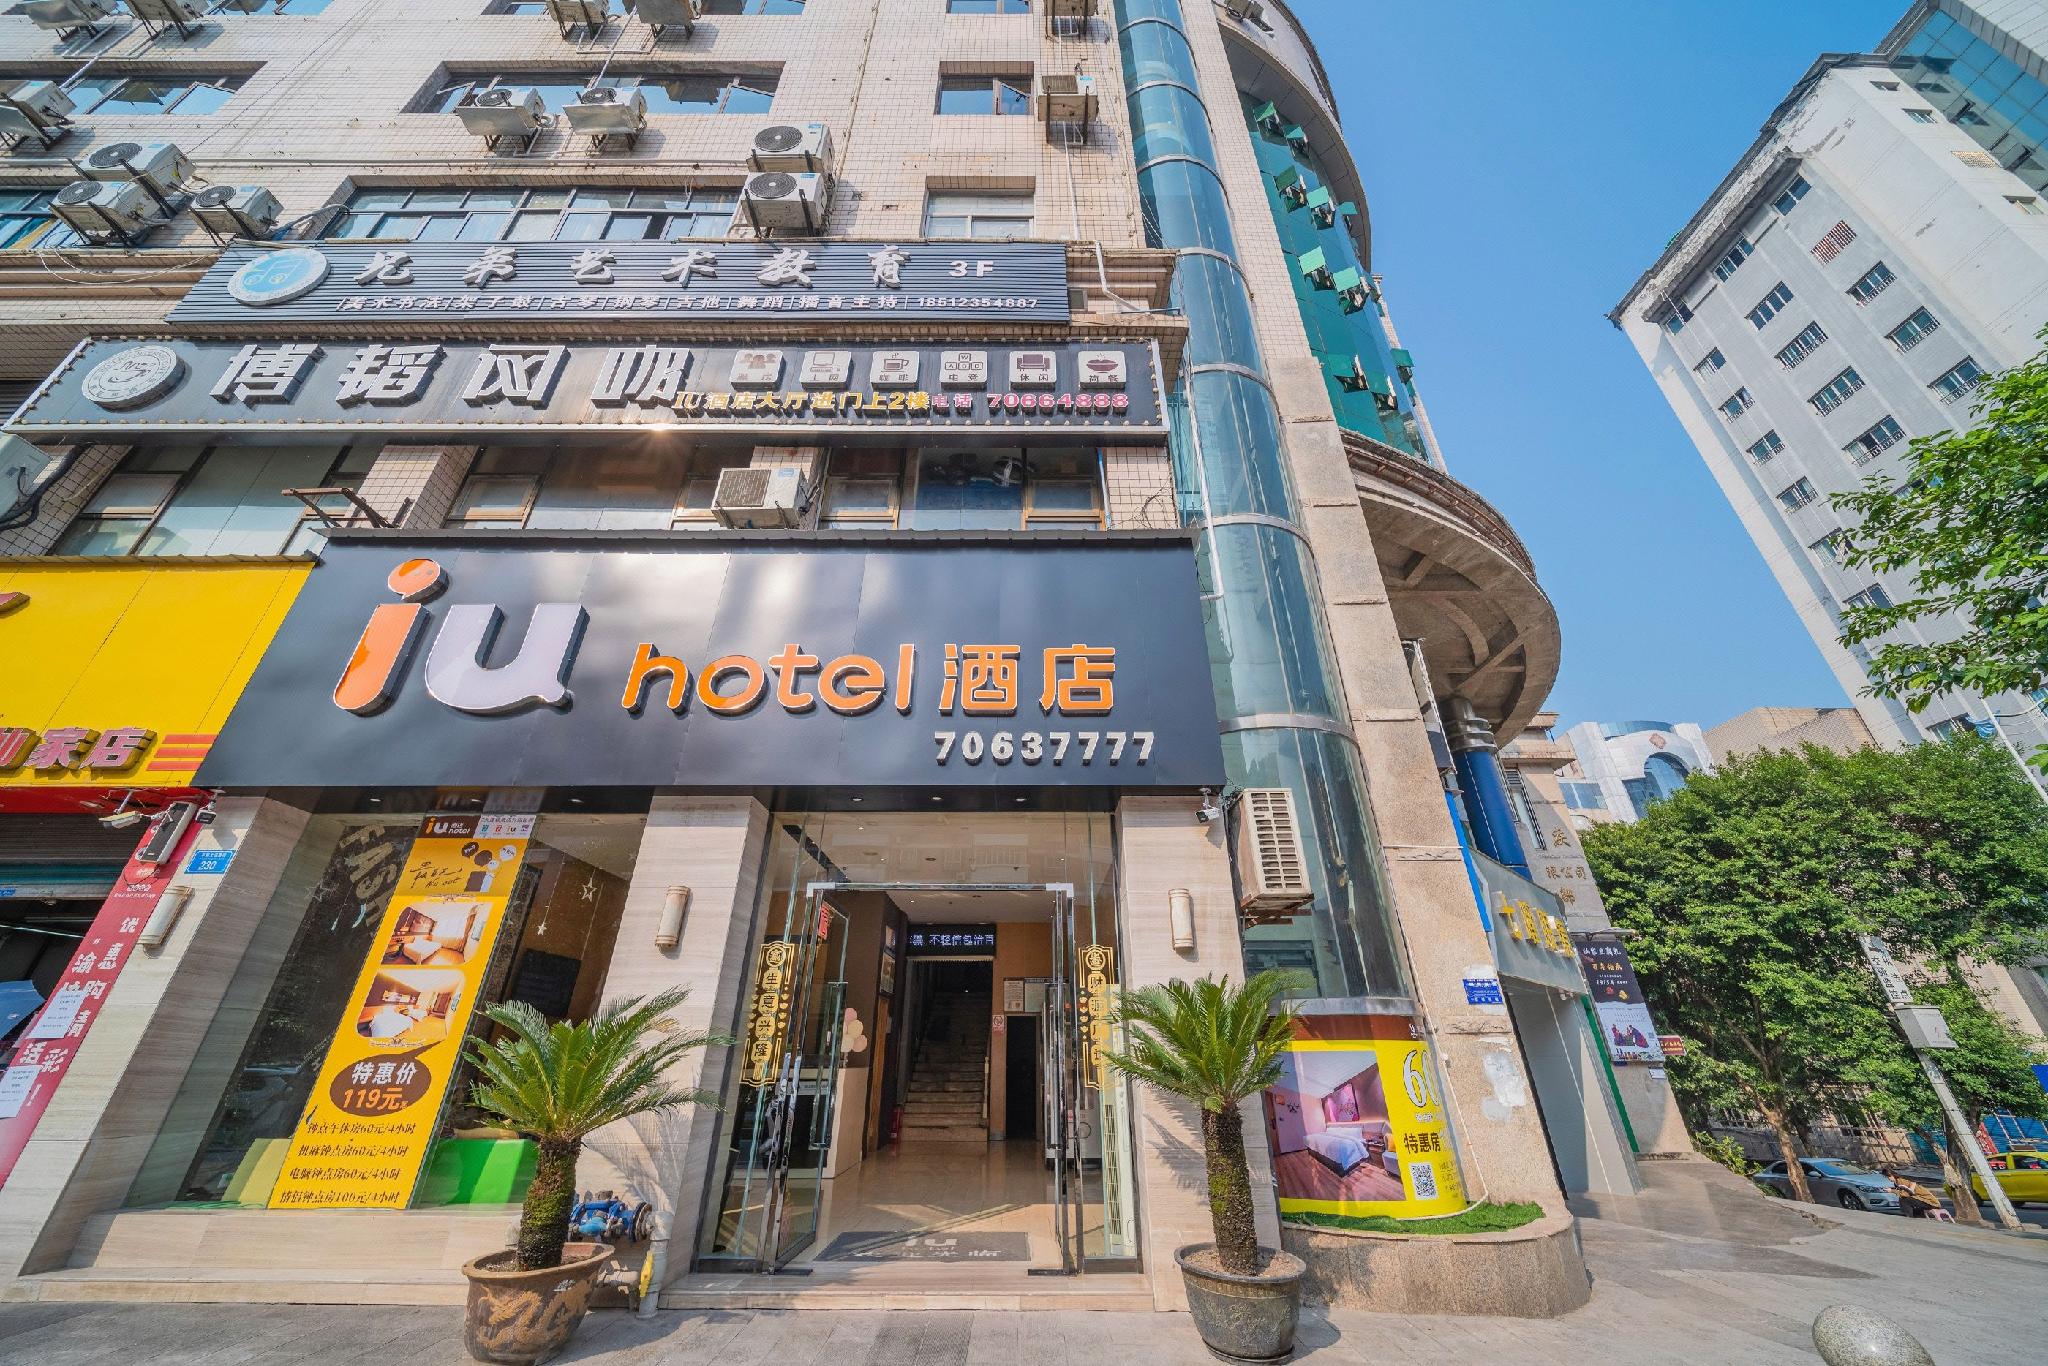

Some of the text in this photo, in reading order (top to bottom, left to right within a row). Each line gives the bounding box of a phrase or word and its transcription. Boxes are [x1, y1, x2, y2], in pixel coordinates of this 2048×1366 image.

[949, 260, 994, 278] 3F
[1020, 373, 1049, 382] 休闲
[986, 393, 1129, 409] 70664888
[621, 642, 1117, 716] hotel 酒店
[934, 731, 1156, 766] 70637777
[755, 972, 780, 1057] 生意兴隆
[351, 1062, 417, 1085] 特惠价
[1403, 1132, 1441, 1154] 特惠房
